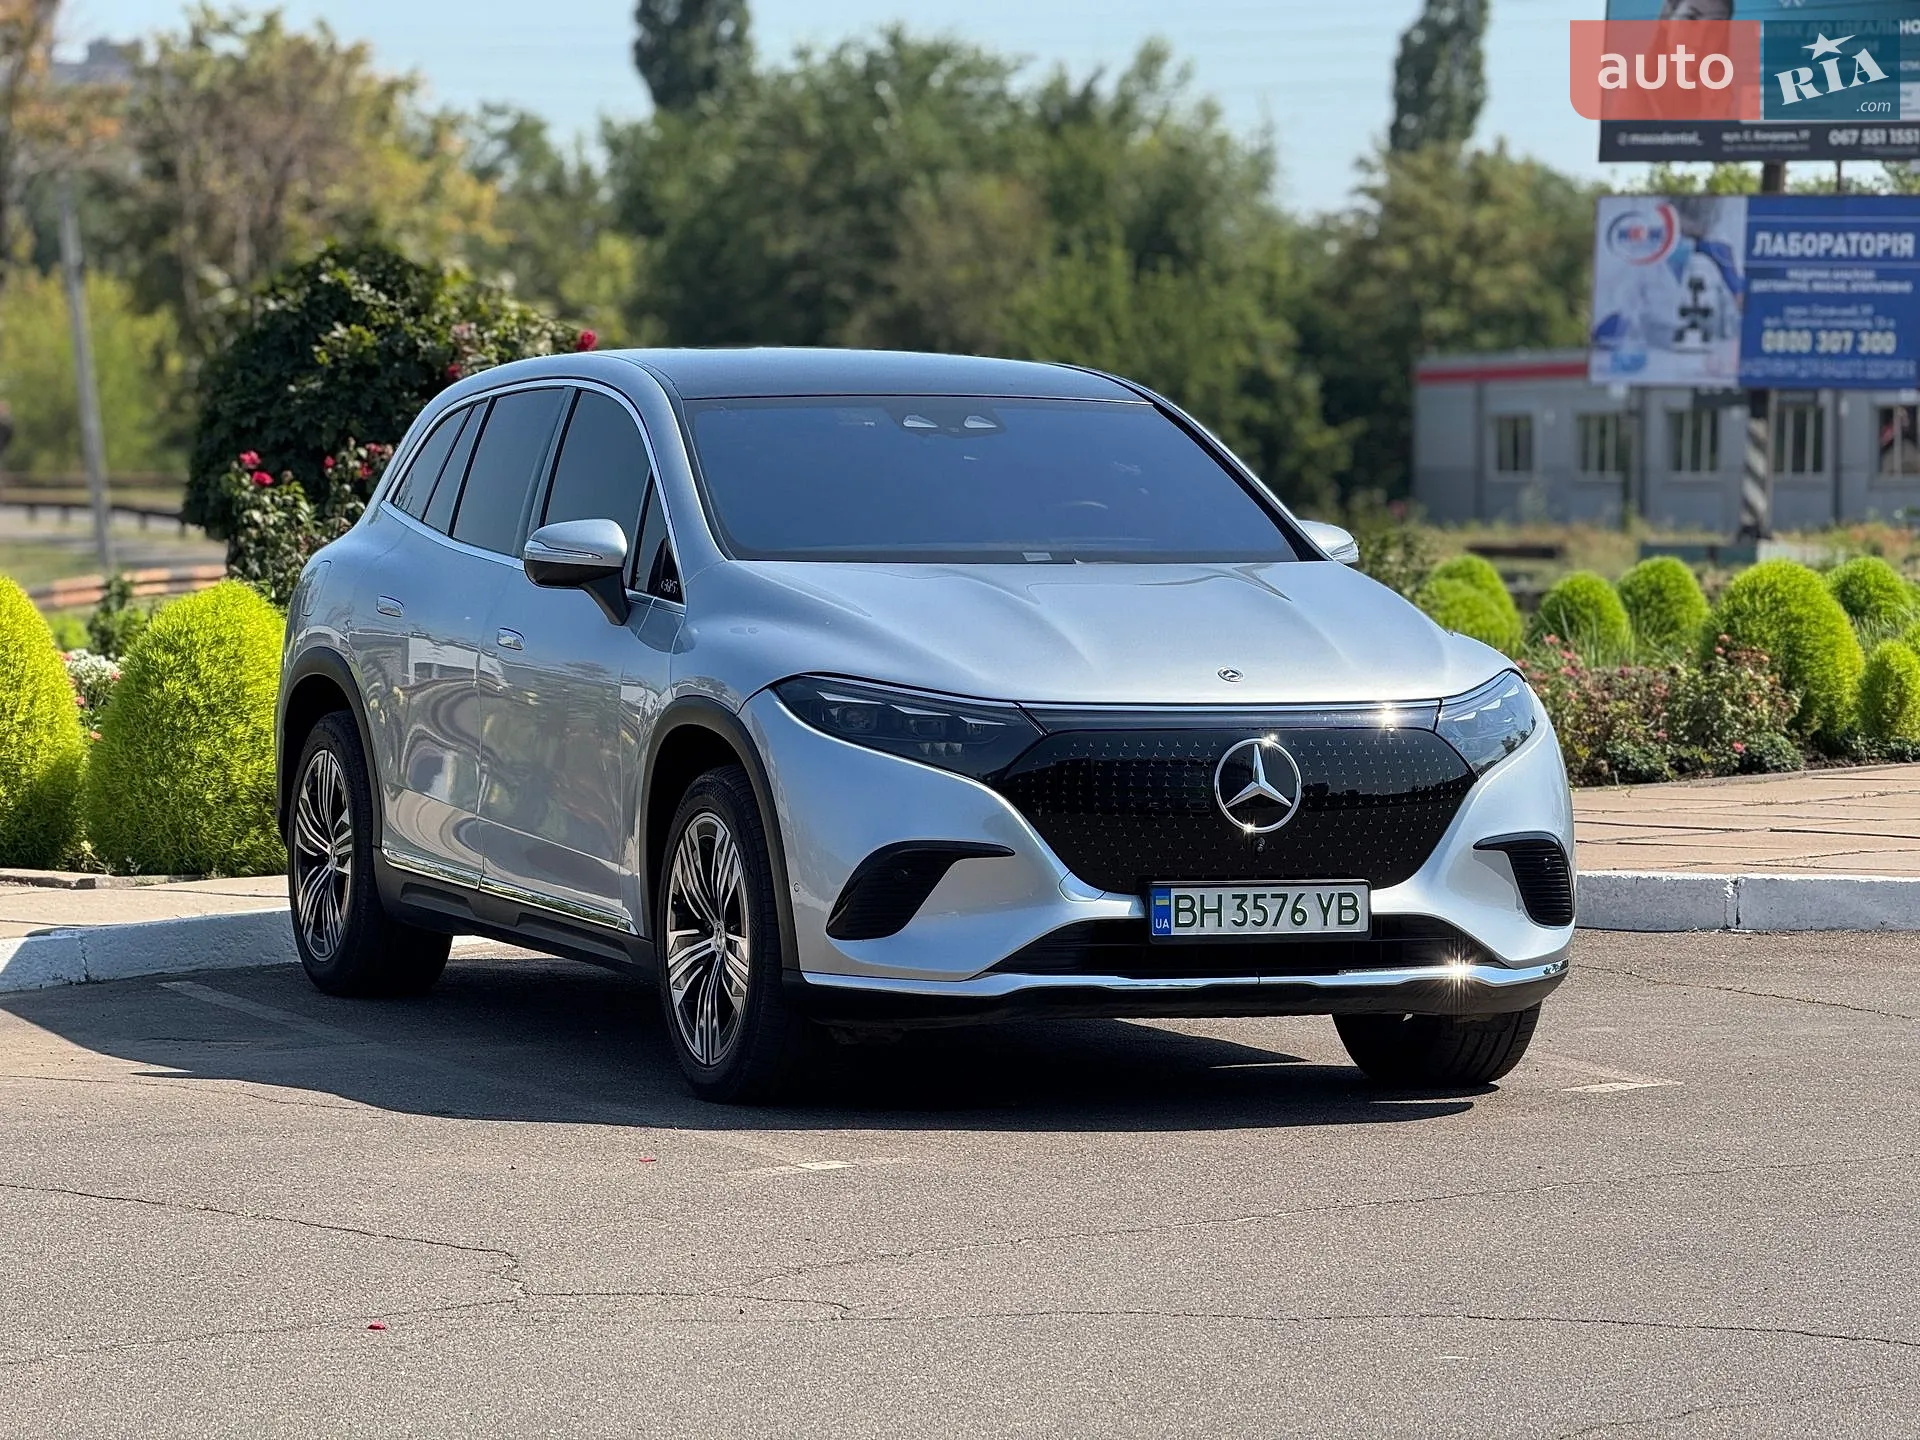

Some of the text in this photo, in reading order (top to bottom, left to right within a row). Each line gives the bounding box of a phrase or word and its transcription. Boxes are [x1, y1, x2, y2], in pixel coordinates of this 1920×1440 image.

[1752, 231, 1915, 259] ЛАБОРАТОРІЯ
[1857, 330, 1896, 354] 300
[1174, 891, 1361, 928] BH 3576 YB
[1155, 918, 1170, 929] UA
